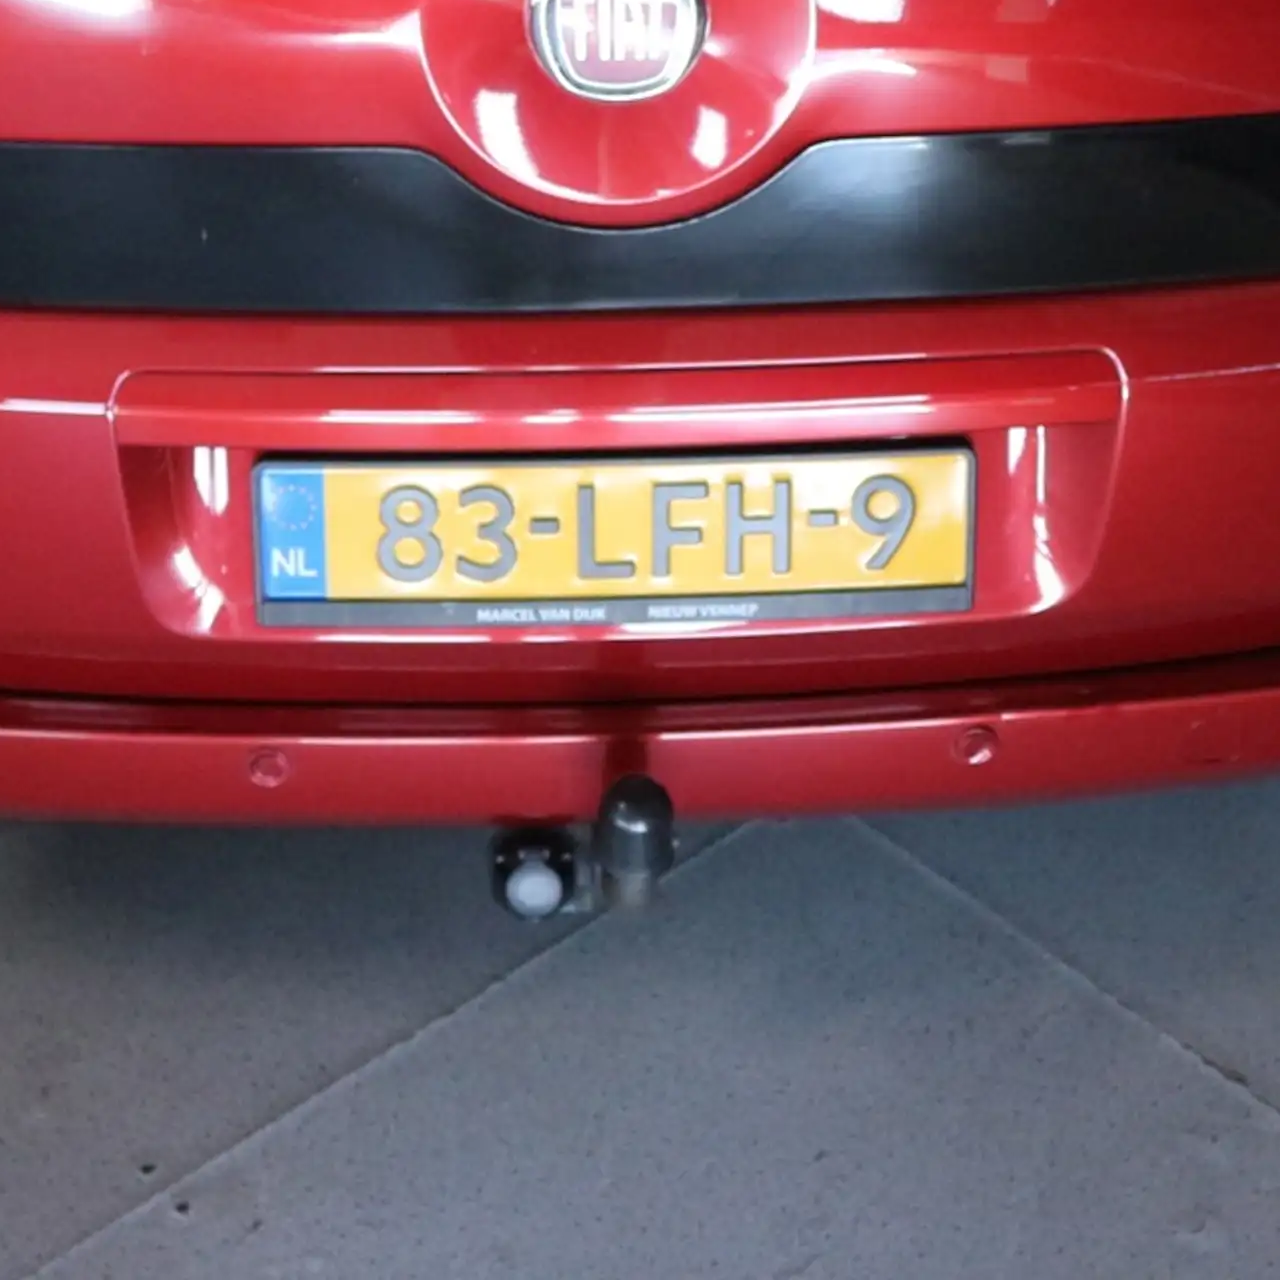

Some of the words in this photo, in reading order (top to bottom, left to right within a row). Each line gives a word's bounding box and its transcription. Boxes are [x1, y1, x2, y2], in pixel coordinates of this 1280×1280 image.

[376, 474, 917, 583] 83-LFH-9
[271, 547, 318, 578] NL
[476, 607, 536, 622] MARCEL
[537, 607, 570, 621] VAN
